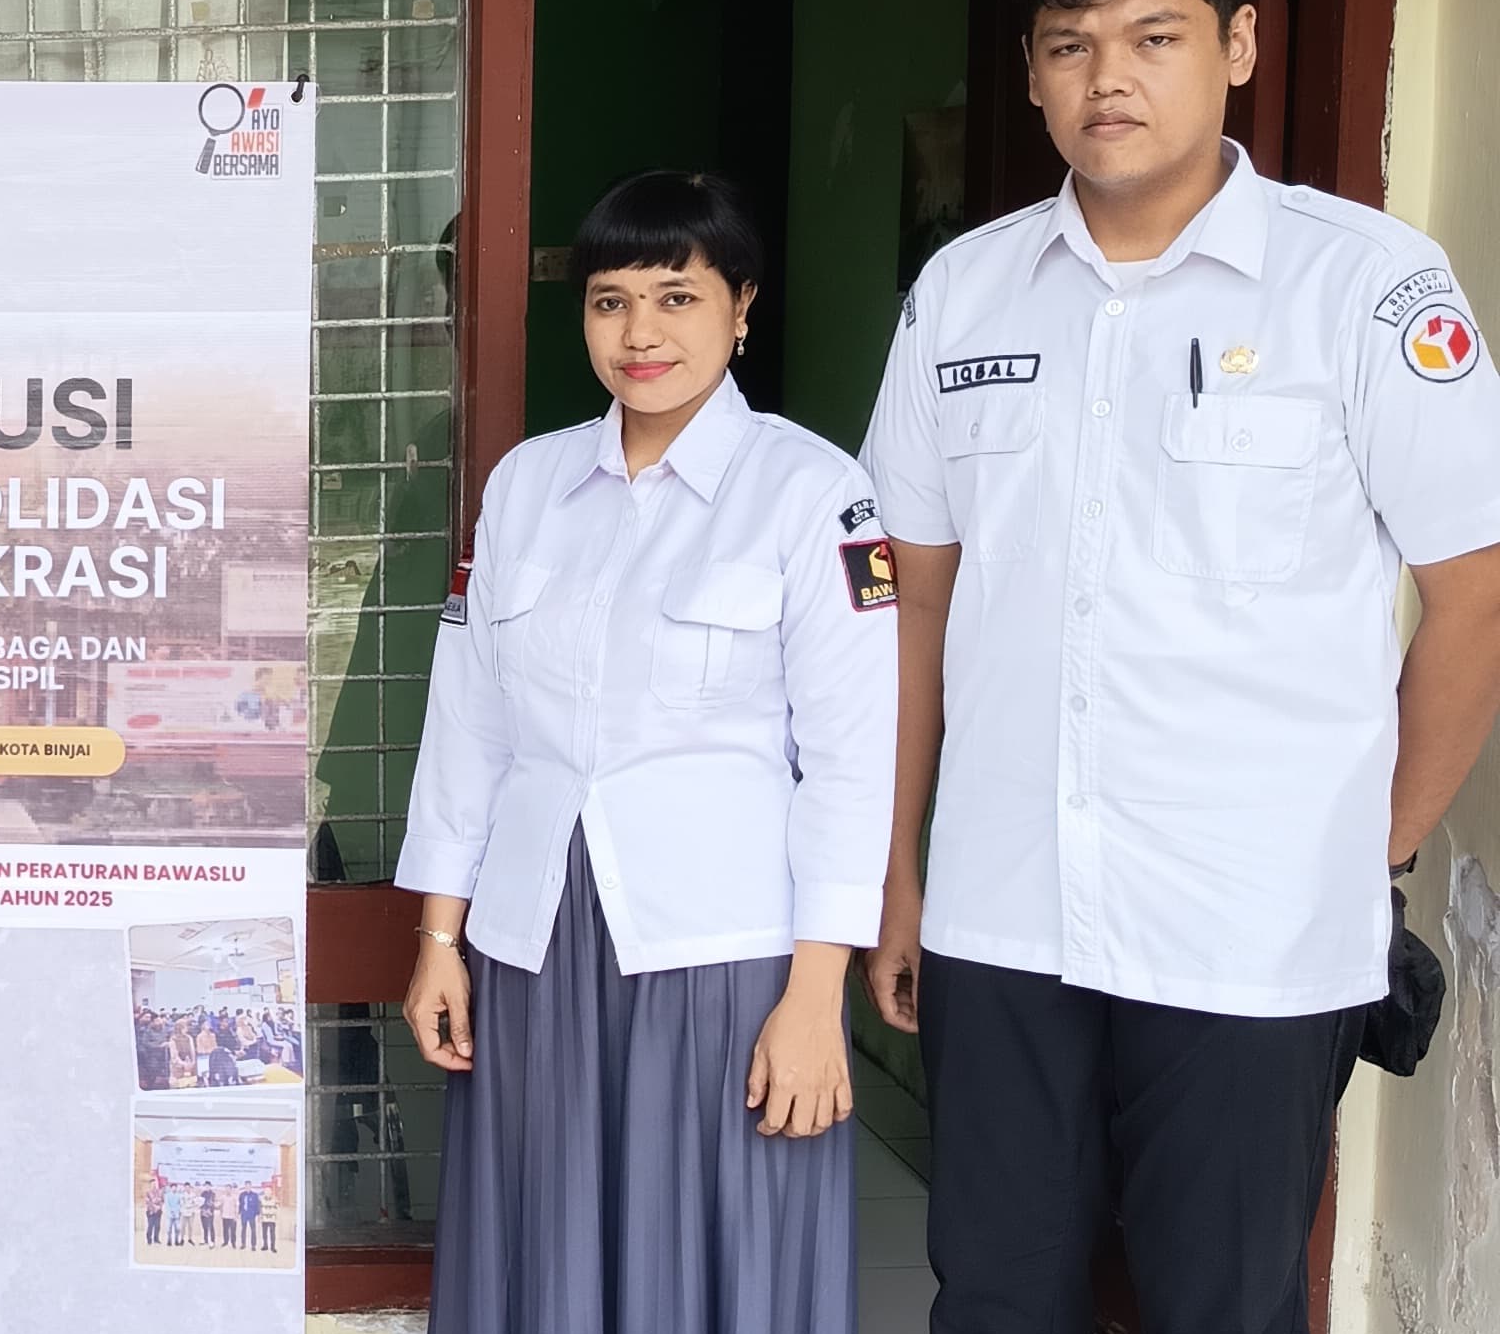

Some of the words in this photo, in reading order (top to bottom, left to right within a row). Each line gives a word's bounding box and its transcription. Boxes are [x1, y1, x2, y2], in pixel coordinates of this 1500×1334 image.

[251, 108, 280, 130] AYO
[231, 131, 279, 153] AWASI
[213, 154, 279, 176] BERSAMA
[1388, 272, 1438, 307] BAWASLU
[1391, 294, 1416, 318] KOTA
[953, 360, 1016, 385] IQBAL
[82, 636, 147, 662] DAN
[0, 743, 40, 757] KOTA
[44, 744, 91, 760] BINJAI
[16, 861, 138, 880] PERATURAN
[143, 863, 246, 882] BAWASLU
[64, 889, 113, 907] 2025
